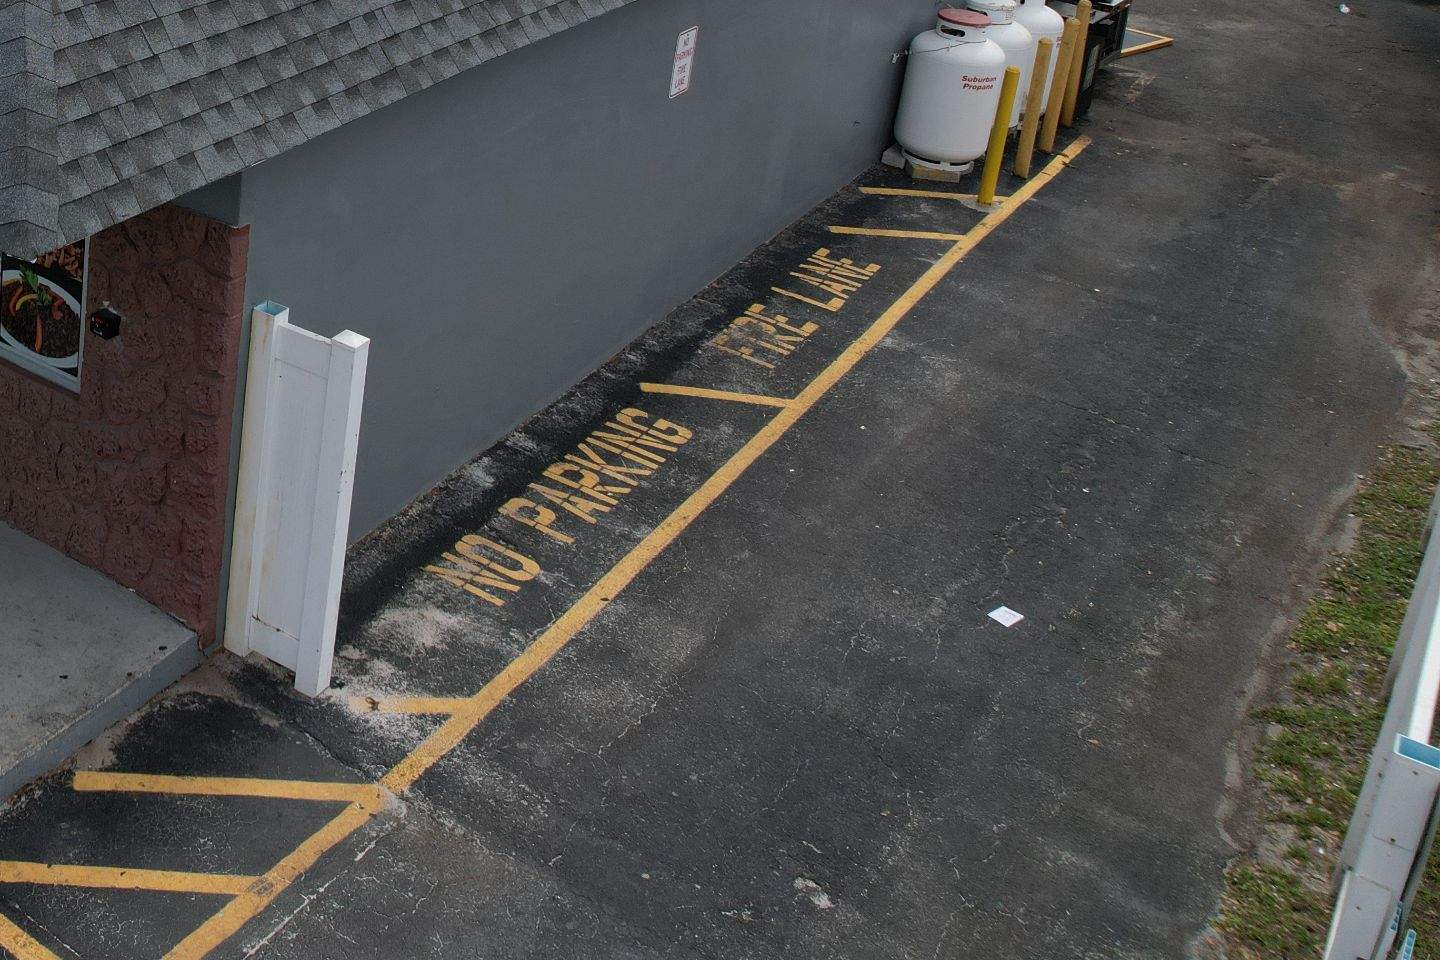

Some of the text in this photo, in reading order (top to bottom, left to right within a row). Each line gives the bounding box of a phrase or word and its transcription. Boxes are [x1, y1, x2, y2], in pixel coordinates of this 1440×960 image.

[961, 75, 997, 83] Suburban
[962, 83, 994, 92] Propane
[423, 247, 881, 607] NO PARKING FIRE LANE
